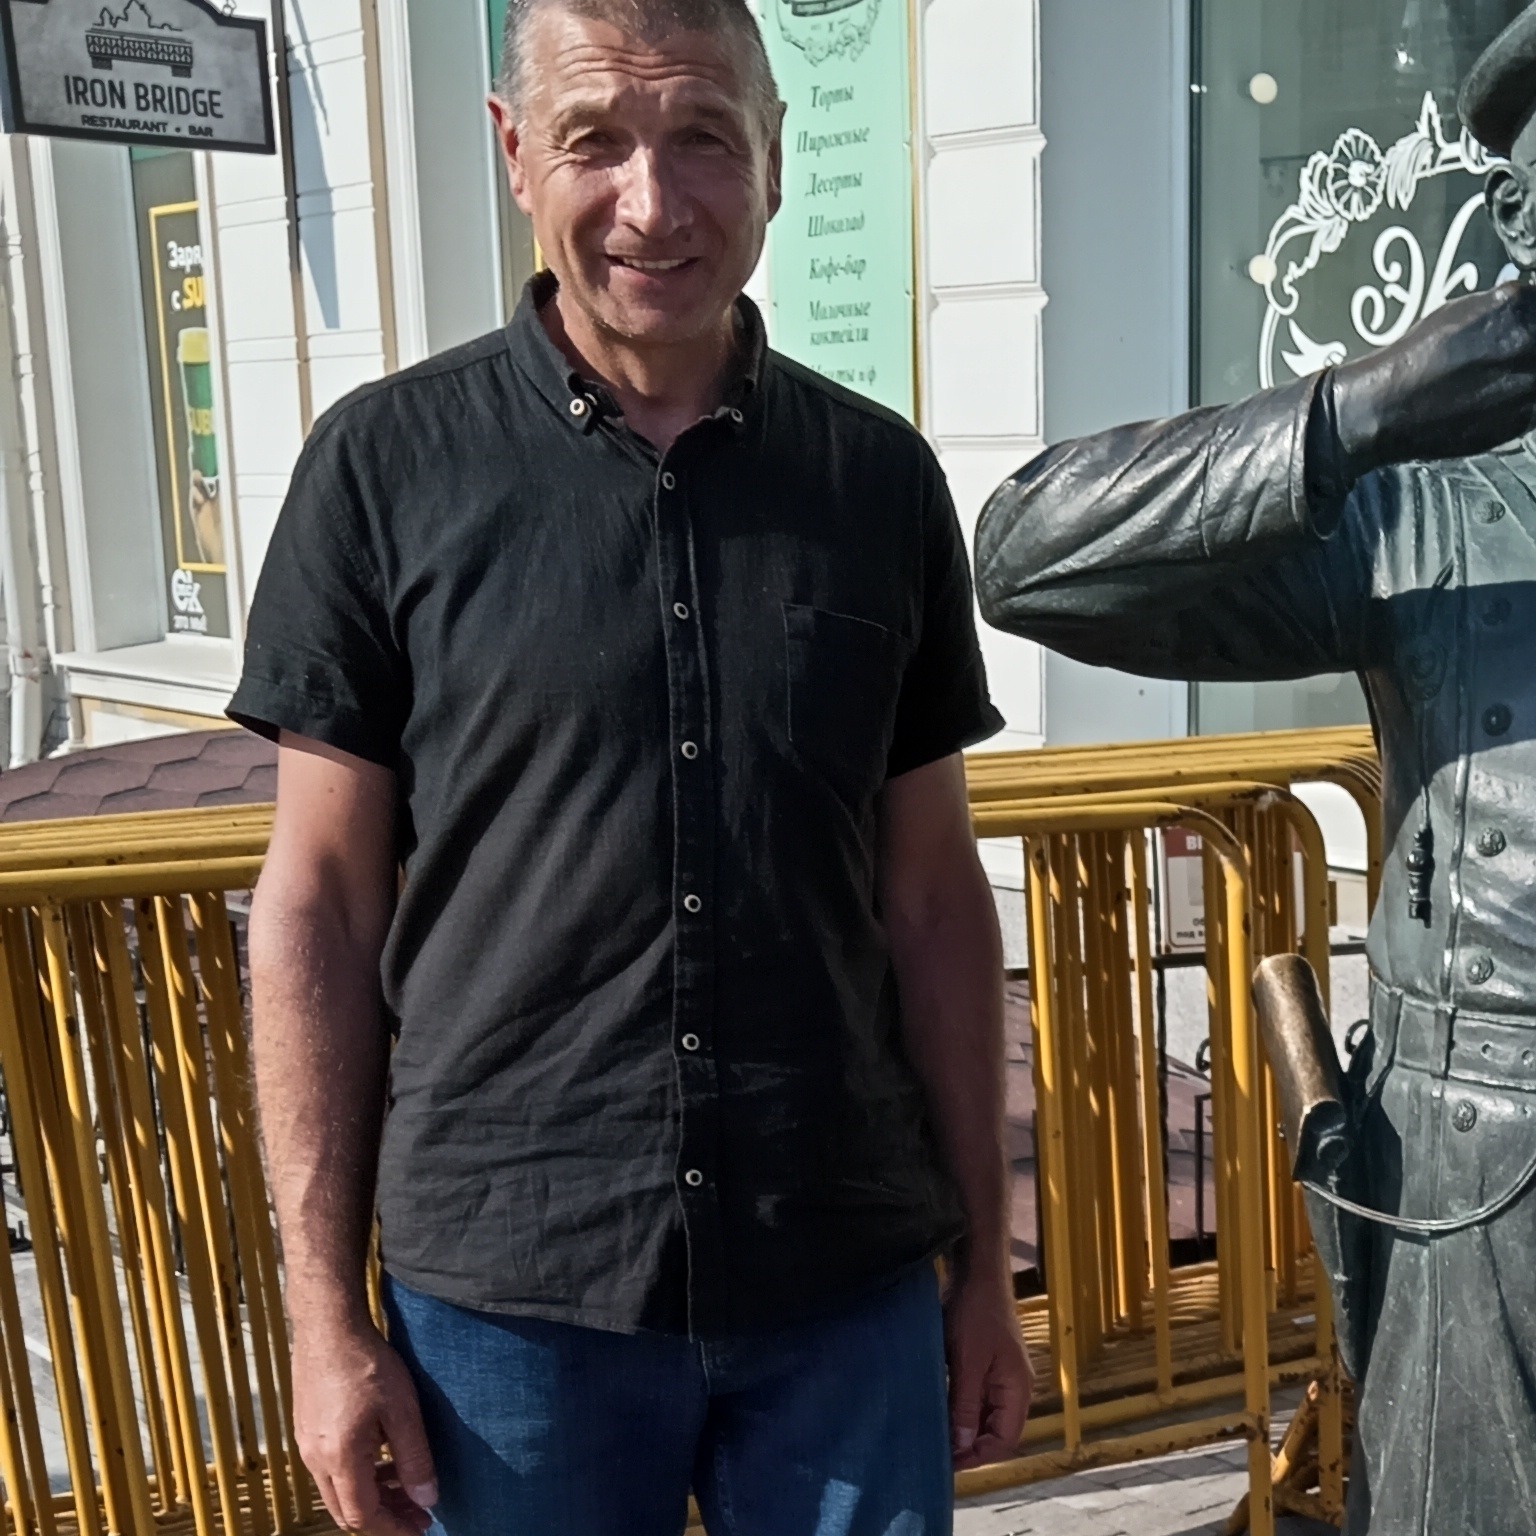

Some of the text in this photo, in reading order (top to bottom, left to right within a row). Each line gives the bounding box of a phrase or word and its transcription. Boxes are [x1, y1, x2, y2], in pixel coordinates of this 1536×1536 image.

[64, 75, 224, 119] IRON BRIDGE
[811, 85, 854, 112] Торты
[81, 114, 213, 138] RESTAURANT BAR
[797, 127, 870, 157] Пирожные
[805, 172, 862, 198] Десерты
[808, 211, 865, 237] Шоколад
[809, 254, 866, 284] Кофе-бар
[809, 300, 871, 321] Молочные
[810, 323, 868, 345] коктейли
